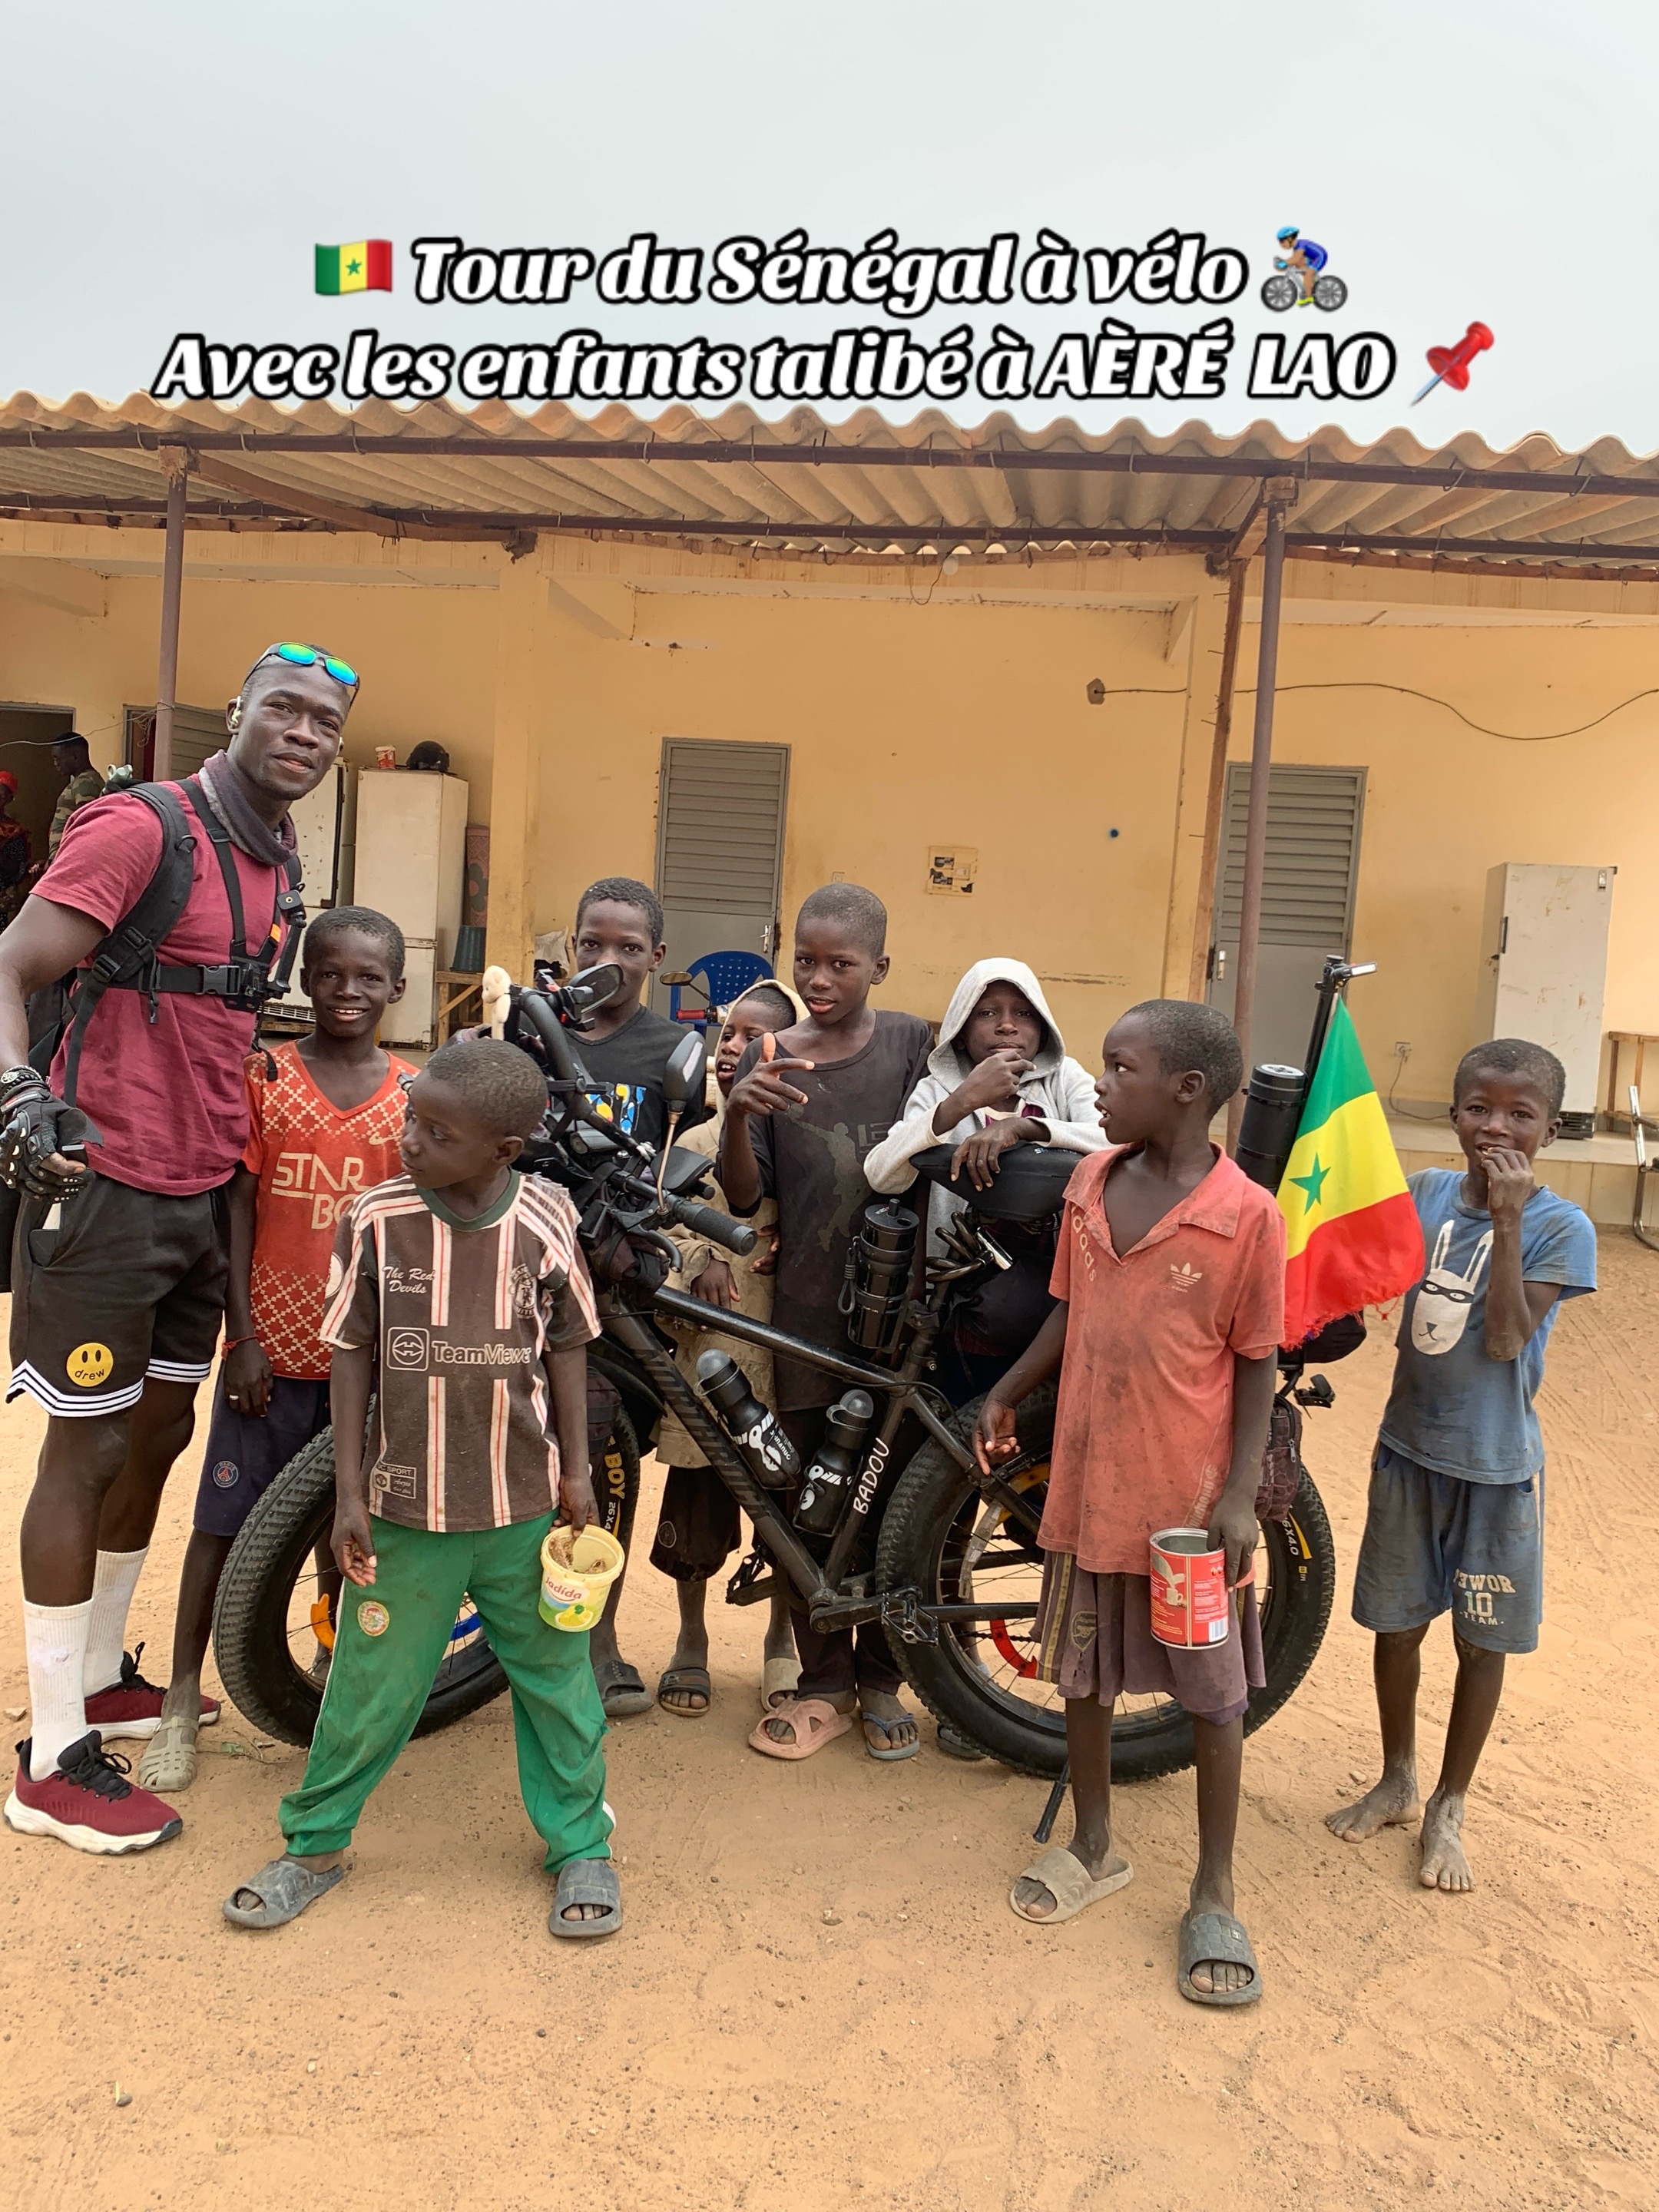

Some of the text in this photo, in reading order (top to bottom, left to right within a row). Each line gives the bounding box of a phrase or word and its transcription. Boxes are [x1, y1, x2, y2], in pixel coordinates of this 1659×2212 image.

[382, 1267, 435, 1281] The Red
[389, 1280, 428, 1294] Devils
[75, 1369, 105, 1381] drew
[386, 1465, 412, 1475] SPORT
[604, 1452, 626, 1500] BOY
[853, 1437, 889, 1515] BADOU
[1281, 1517, 1299, 1556] 6X4.0
[1464, 1591, 1493, 1618] 10
